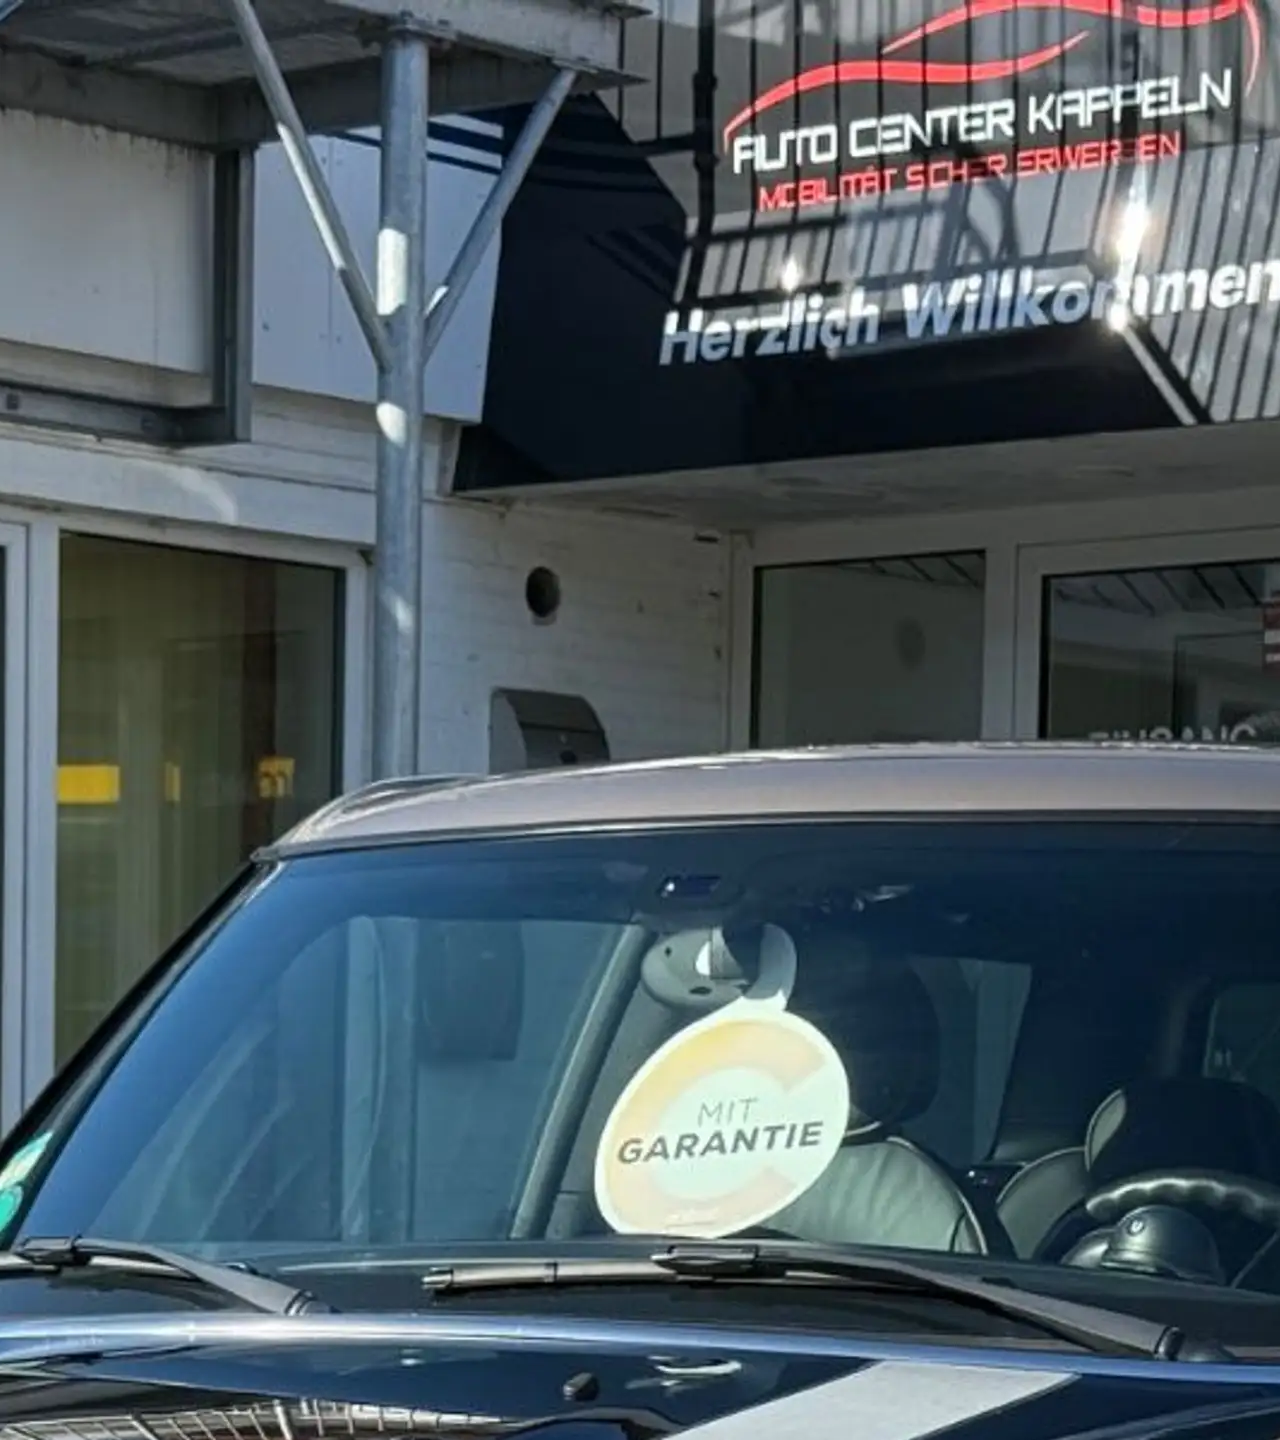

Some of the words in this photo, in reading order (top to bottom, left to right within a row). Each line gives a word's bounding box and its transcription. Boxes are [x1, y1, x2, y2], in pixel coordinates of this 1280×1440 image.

[733, 124, 838, 174] AUTO
[849, 98, 1015, 158] CENTER
[904, 153, 1008, 193] SCHER
[1016, 130, 1181, 177] ERWEREN
[659, 287, 880, 366] Herzlich
[617, 1121, 824, 1165] GARANTIE
[697, 1096, 759, 1127] MIT
